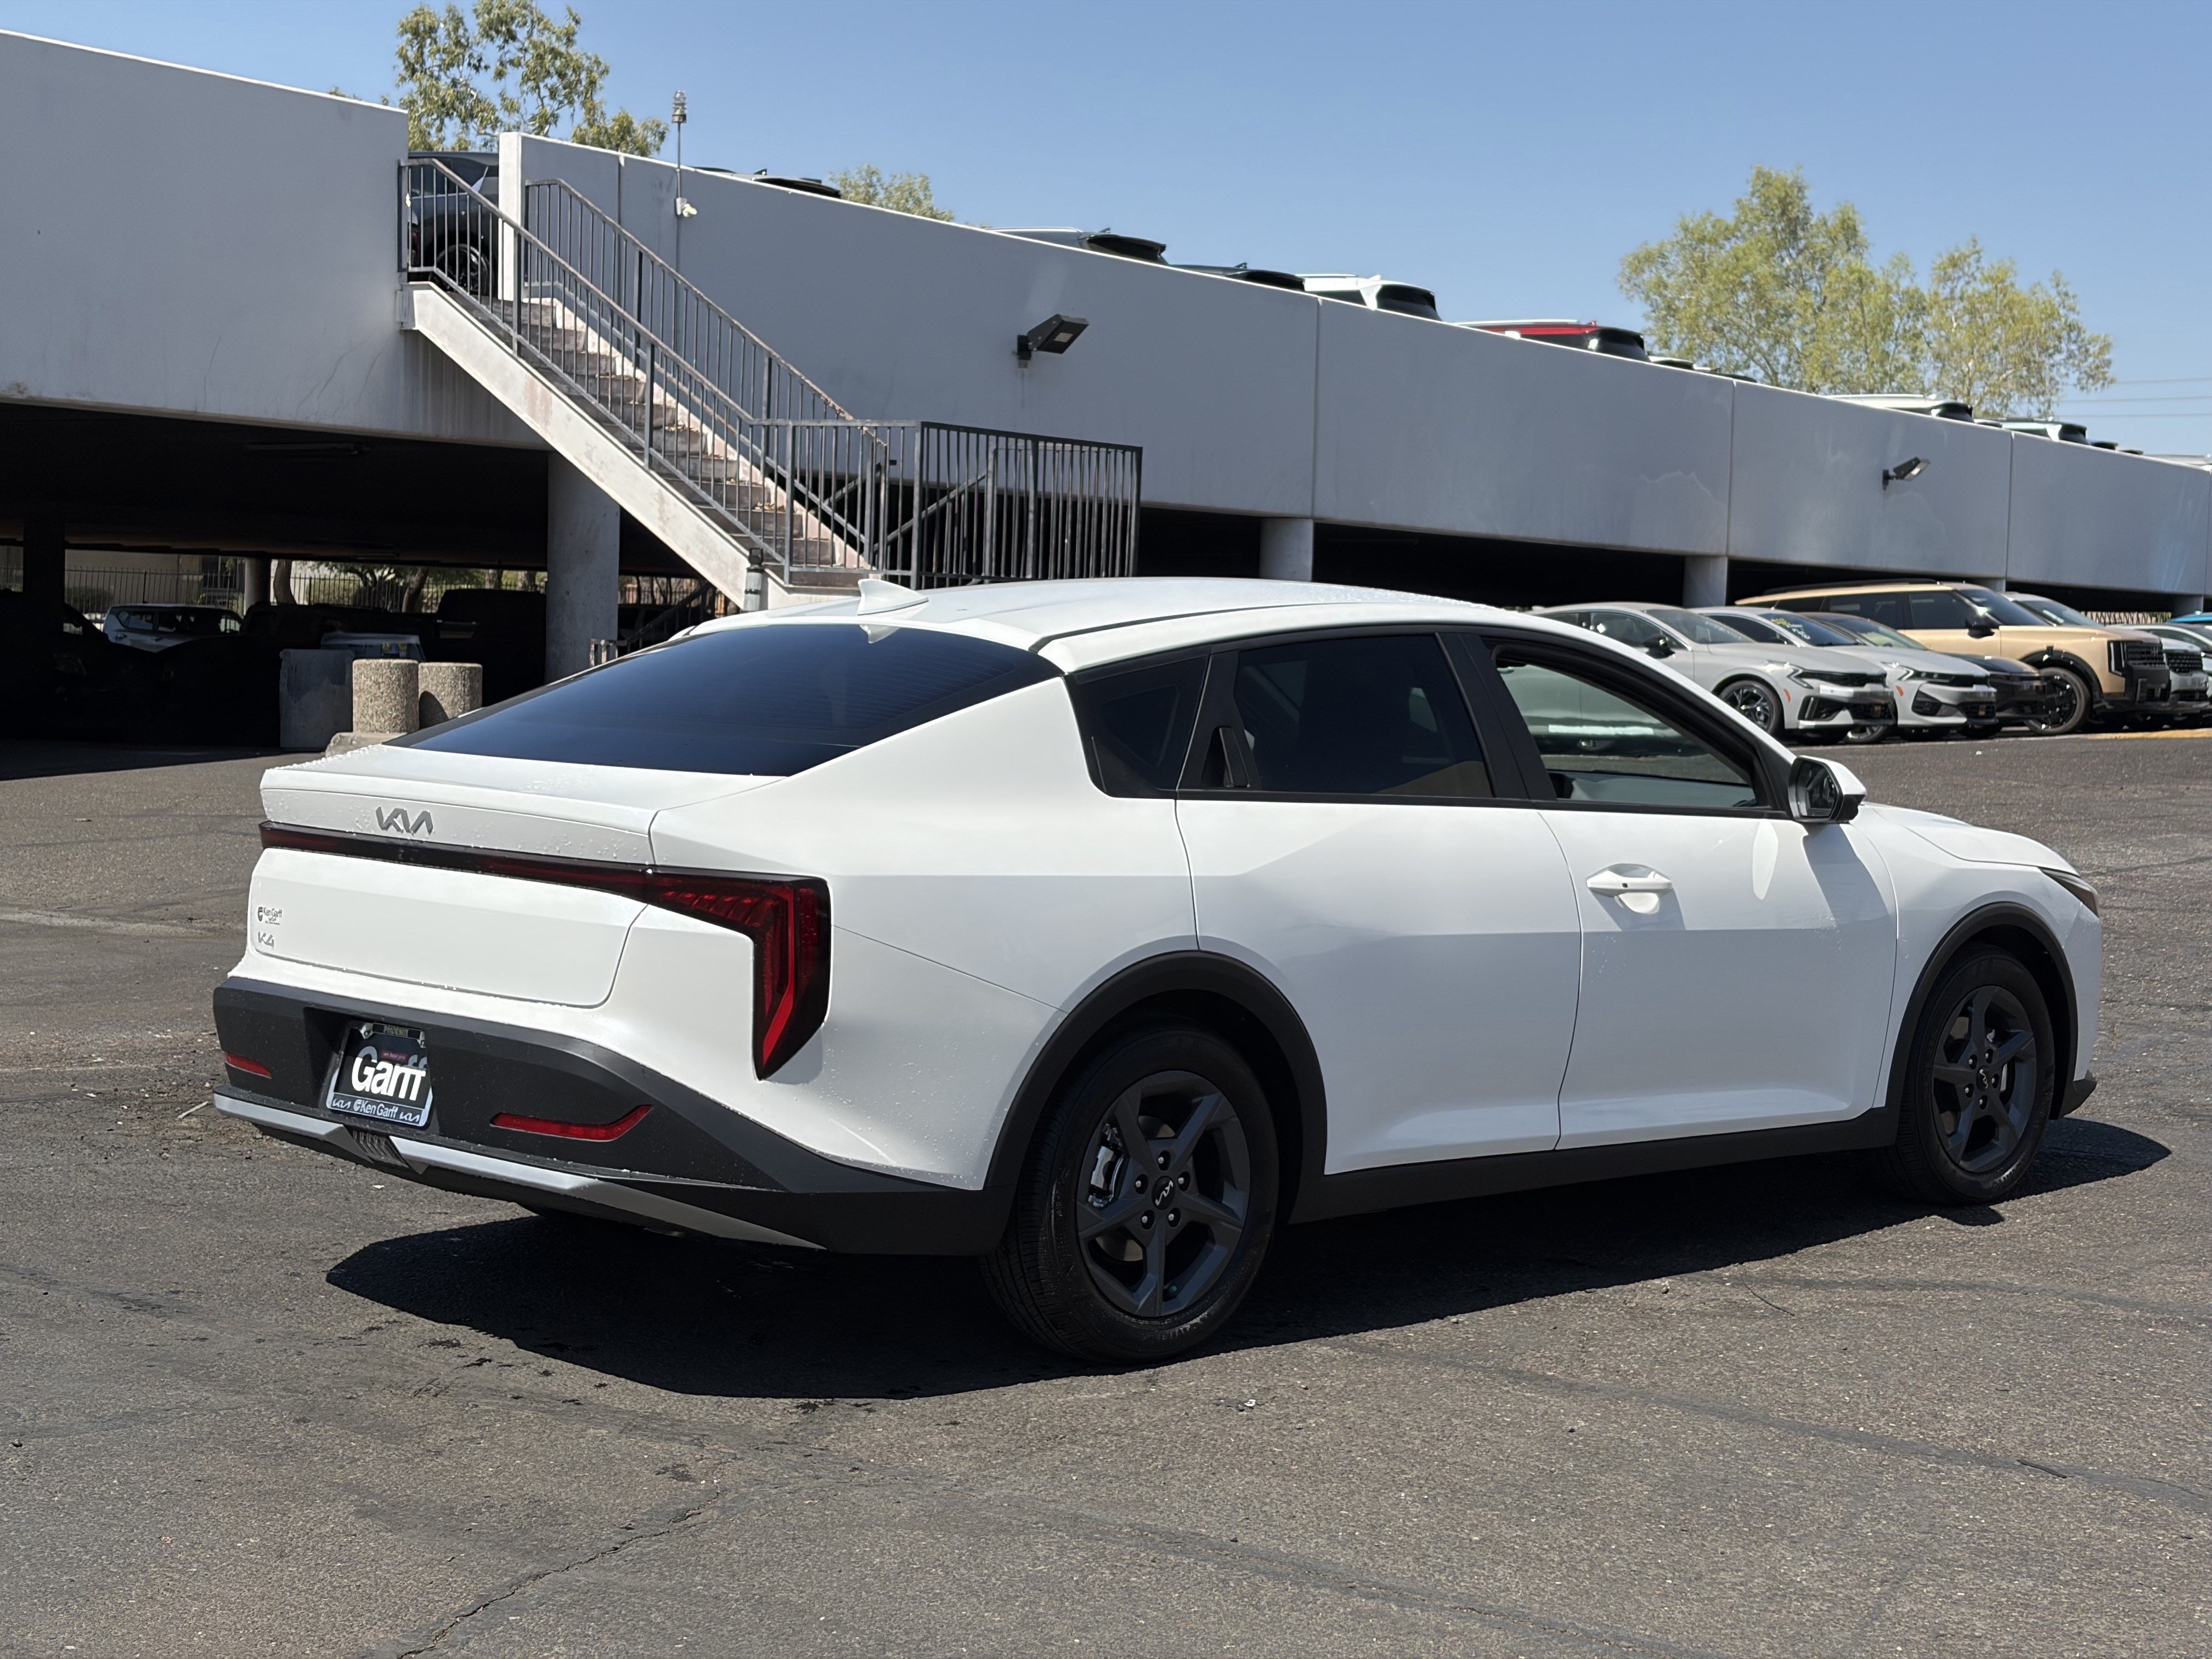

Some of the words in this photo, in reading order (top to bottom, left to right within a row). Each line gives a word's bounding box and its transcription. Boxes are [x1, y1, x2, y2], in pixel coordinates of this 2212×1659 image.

[375, 806, 433, 836] KIA
[258, 931, 275, 949] K4
[352, 1046, 428, 1101] Garff
[360, 1101, 376, 1114] Ken
[376, 1103, 399, 1119] Garff
